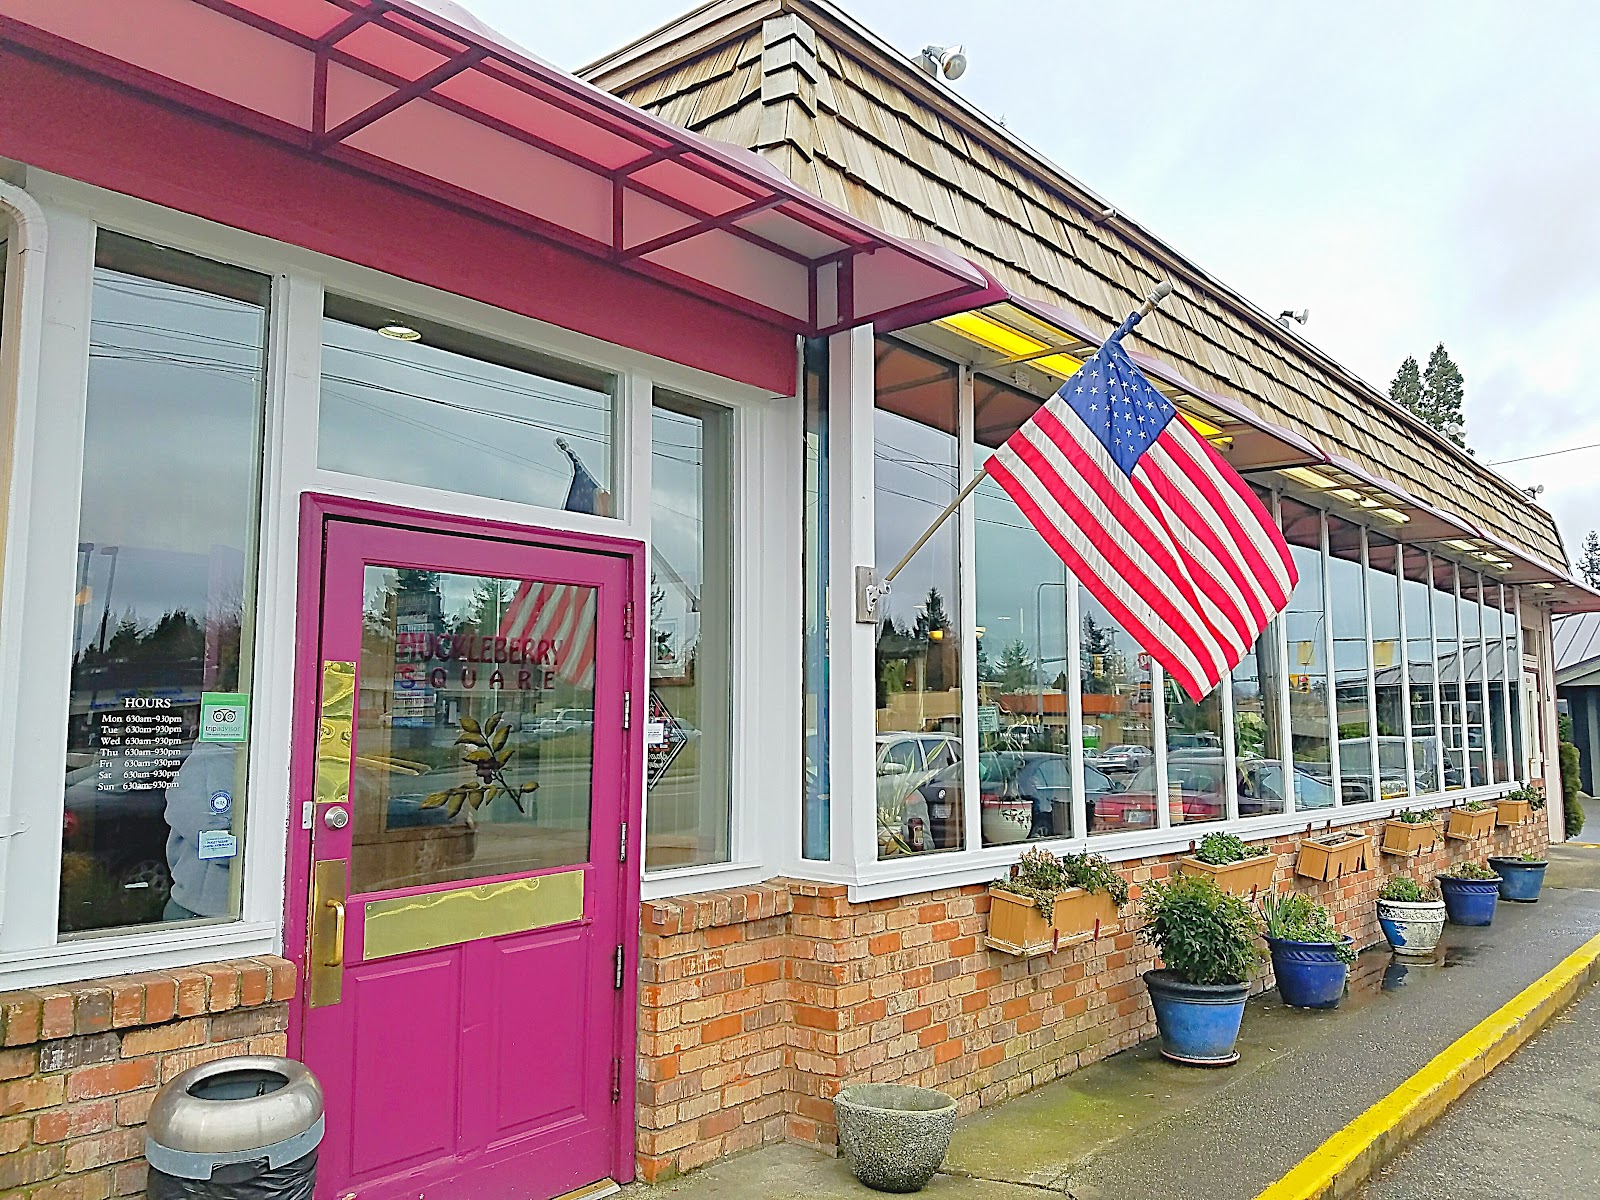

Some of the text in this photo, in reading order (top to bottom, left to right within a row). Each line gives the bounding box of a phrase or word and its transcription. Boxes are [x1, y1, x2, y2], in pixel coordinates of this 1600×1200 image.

[398, 632, 563, 665] HUCKLEBERRY
[400, 666, 556, 690] SQUARE
[124, 697, 171, 709] HOURS
[101, 714, 123, 723] Mon
[100, 725, 119, 734] Tue
[205, 725, 241, 733] tripadvisor
[100, 736, 121, 745] Wed
[100, 748, 119, 756] Thu
[99, 760, 113, 768] Fri
[98, 771, 112, 779] Sat
[97, 782, 115, 791] Sun
